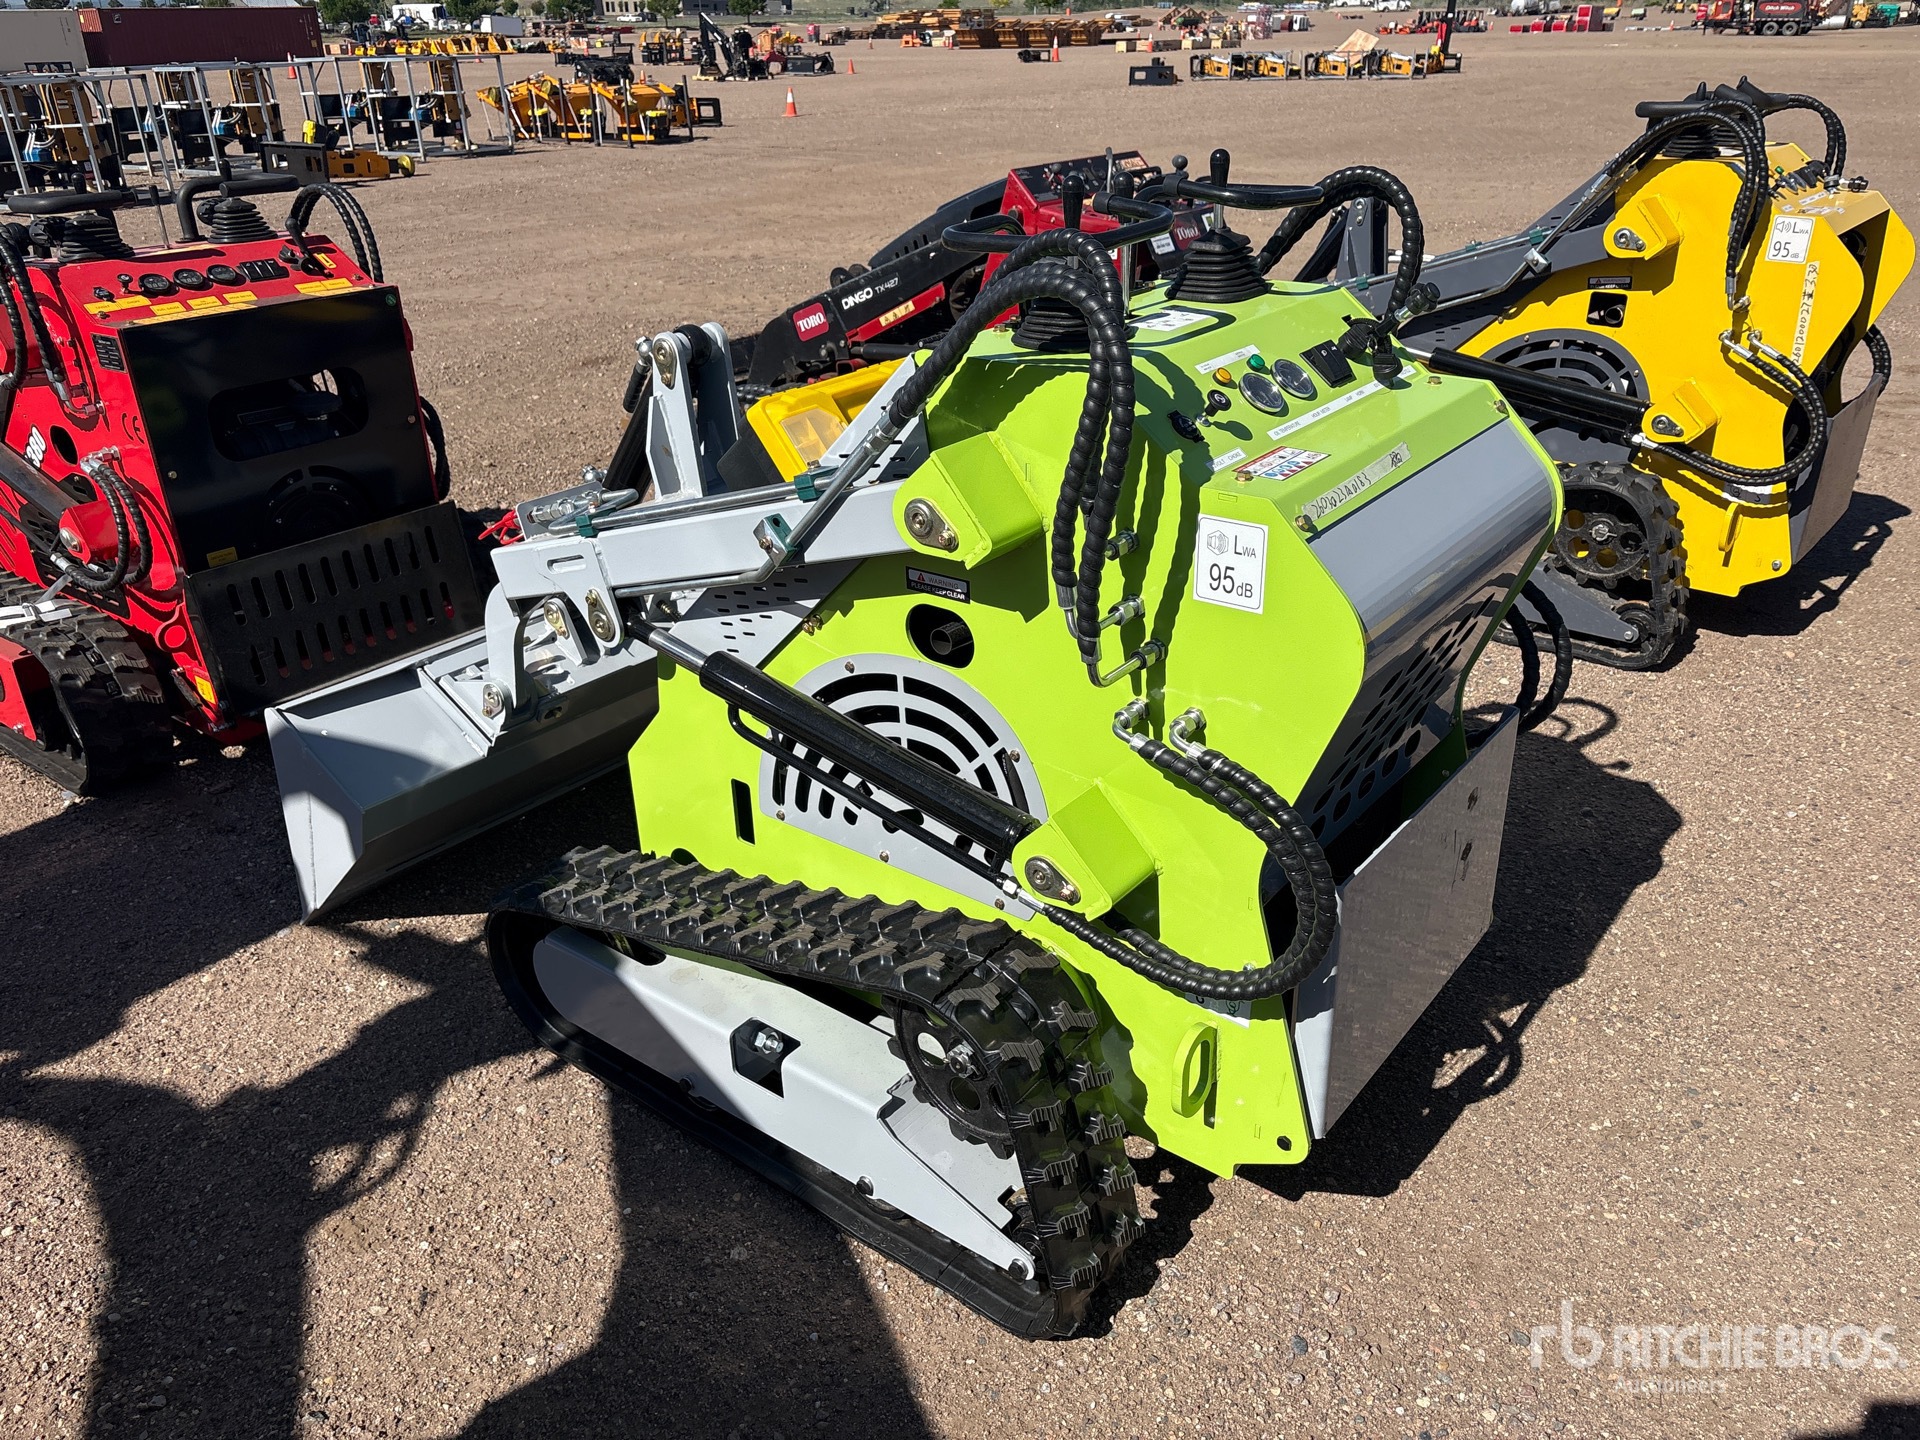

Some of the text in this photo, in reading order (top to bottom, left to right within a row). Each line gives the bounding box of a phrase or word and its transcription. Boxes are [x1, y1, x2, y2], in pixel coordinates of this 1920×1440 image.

[841, 287, 873, 310] DINGO
[797, 312, 826, 332] TORO
[1228, 451, 1241, 461] CHOKE
[1234, 534, 1257, 559] LWA
[911, 581, 966, 600] PLEASE KEEP CLEAR
[929, 576, 959, 589] WARNING
